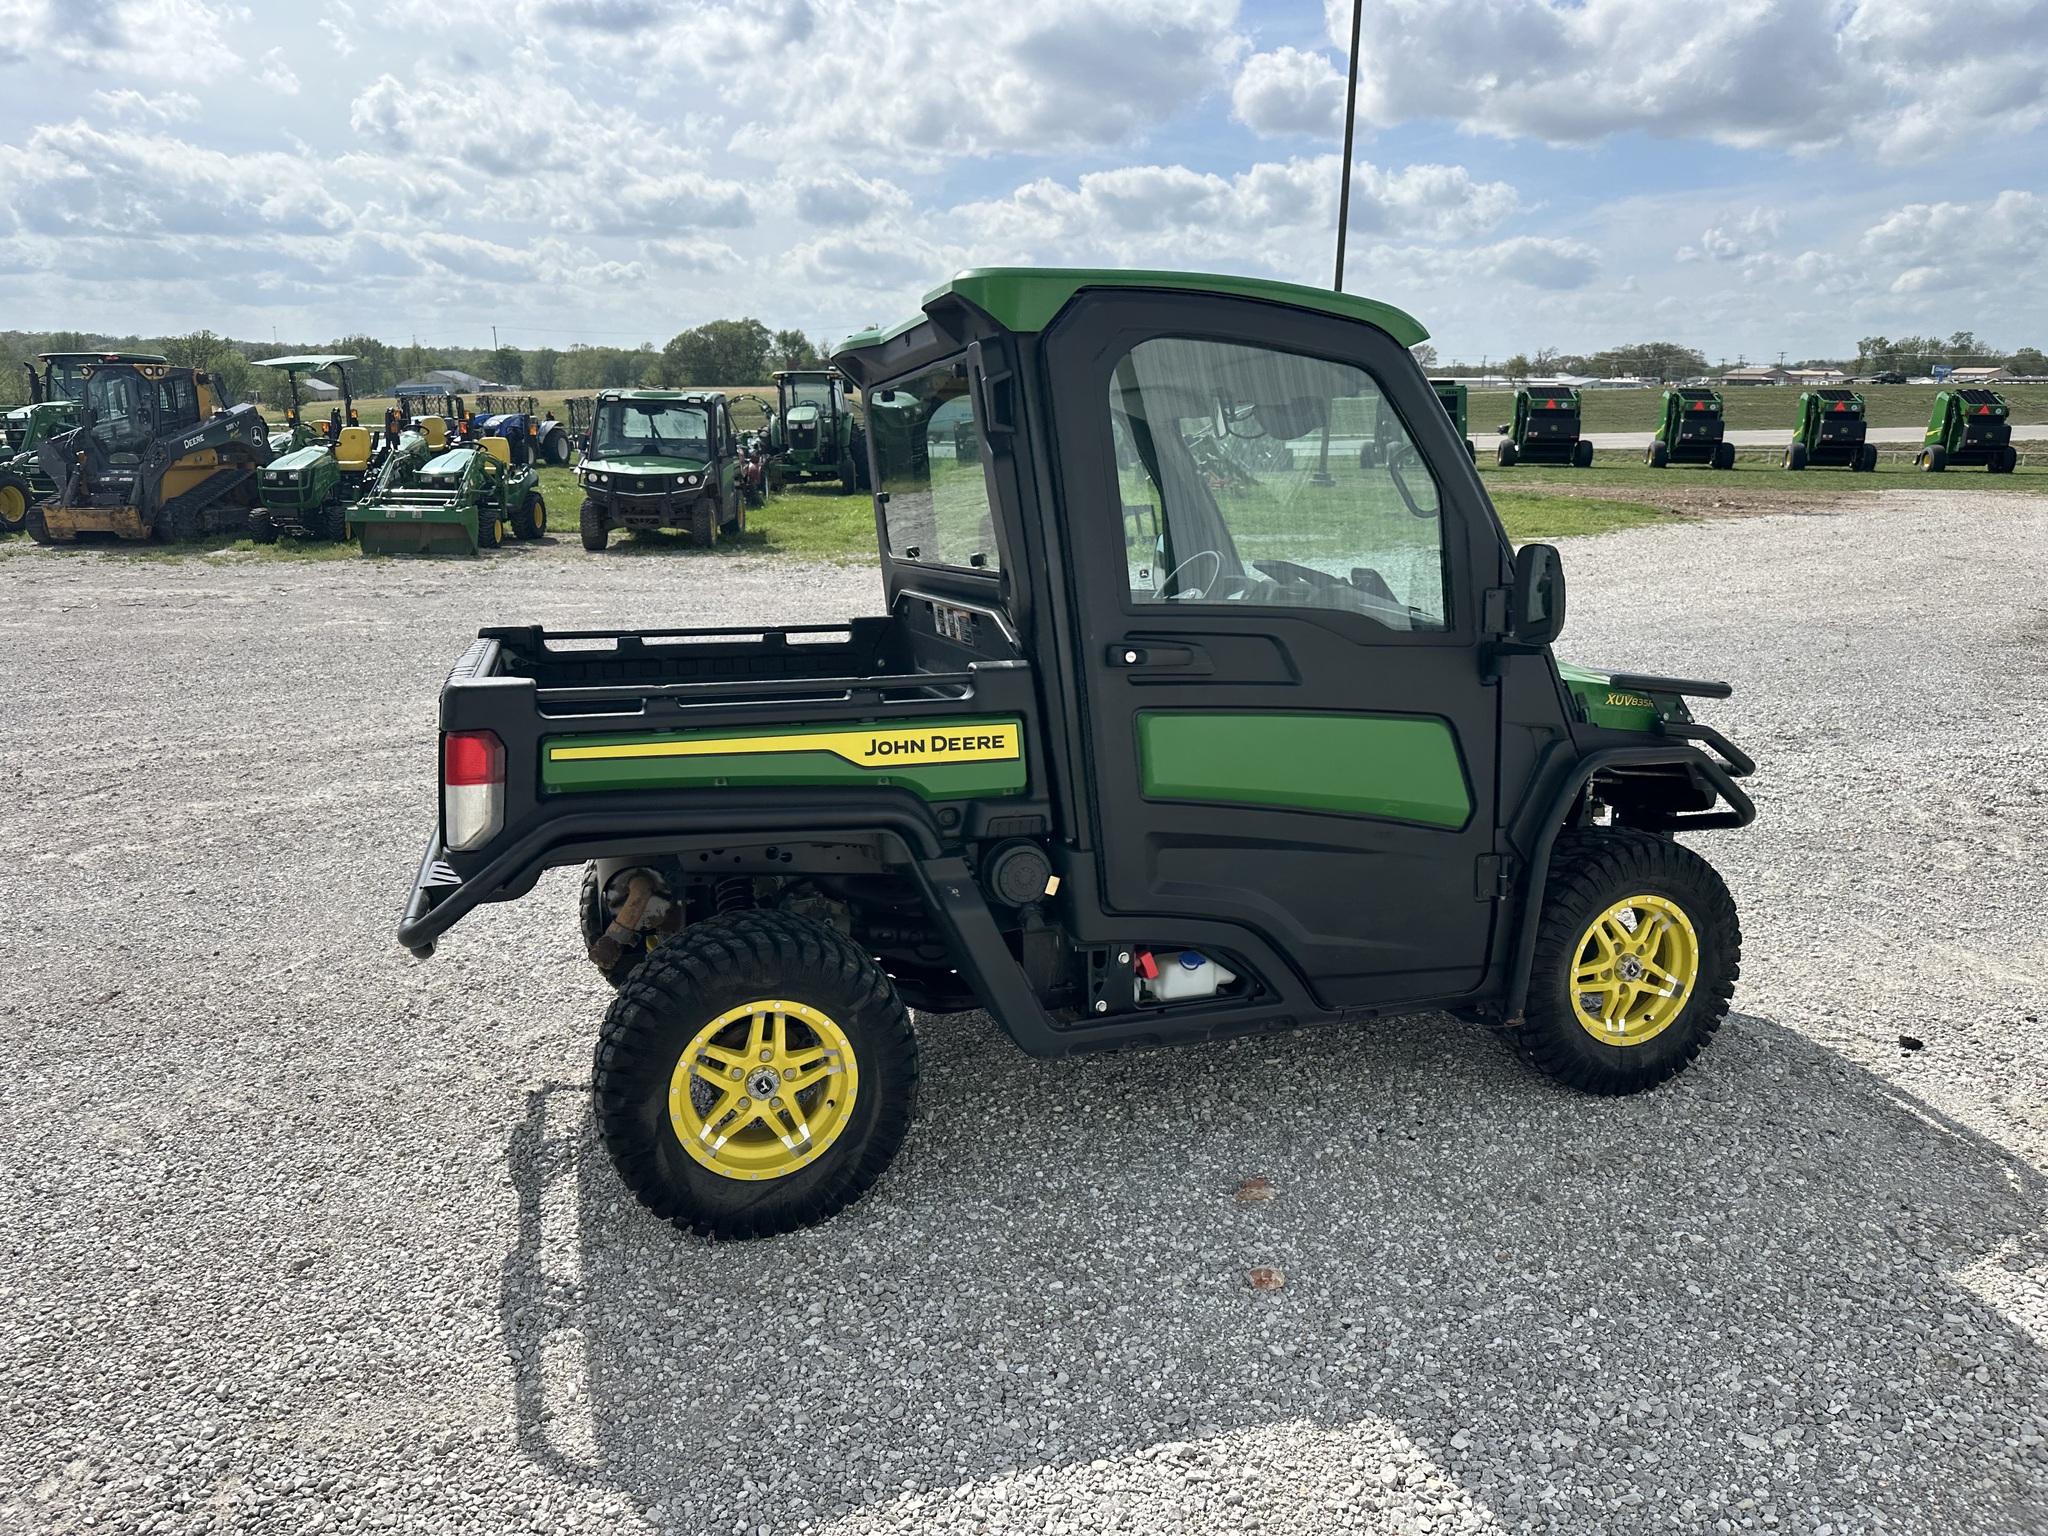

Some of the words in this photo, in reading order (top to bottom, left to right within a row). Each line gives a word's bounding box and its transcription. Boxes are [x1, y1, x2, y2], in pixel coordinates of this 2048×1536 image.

[184, 434, 205, 449] DEERE
[864, 738, 925, 757] JOHN
[931, 735, 1005, 752] DEERE
